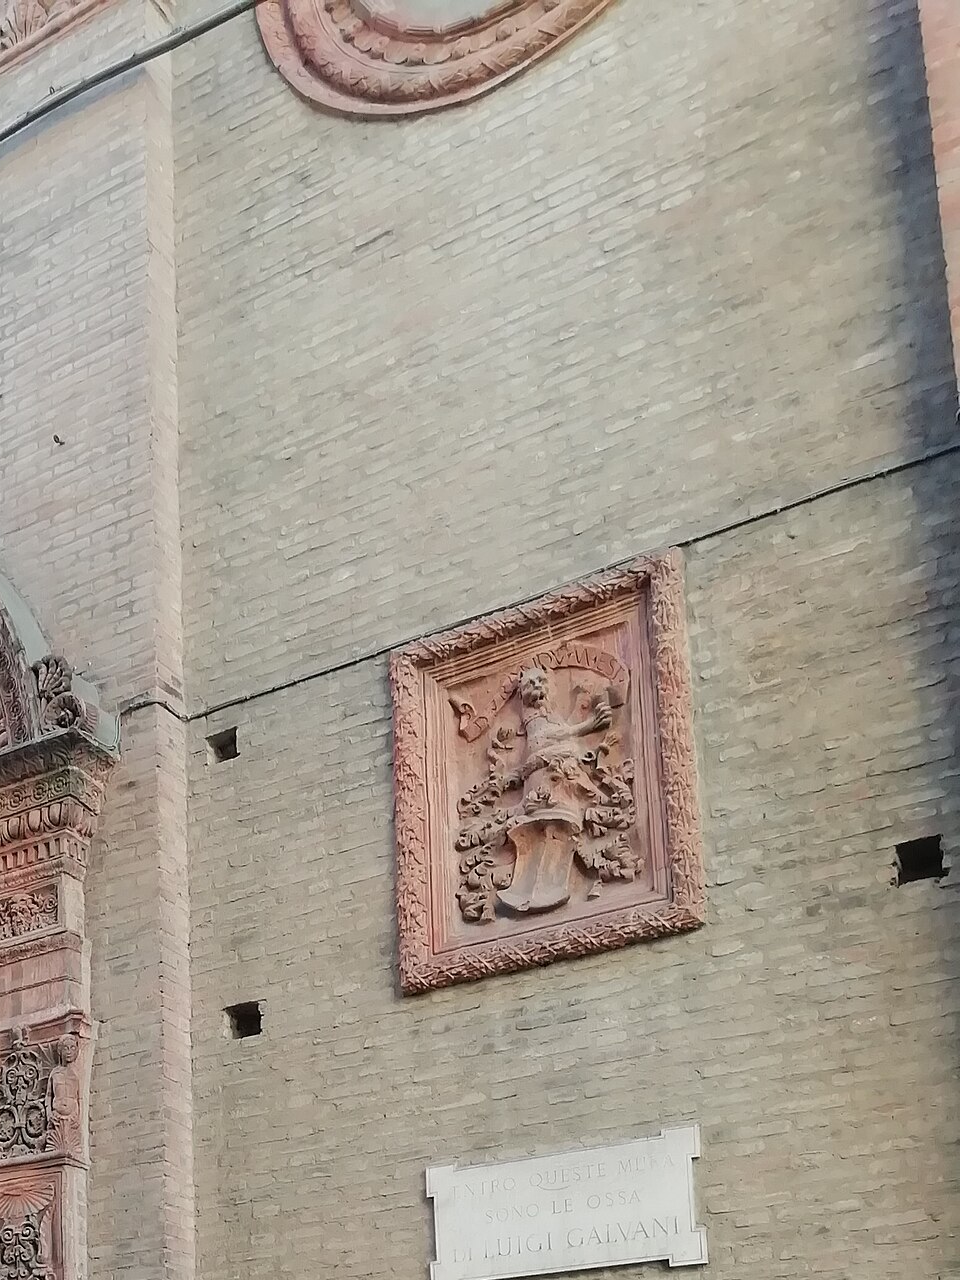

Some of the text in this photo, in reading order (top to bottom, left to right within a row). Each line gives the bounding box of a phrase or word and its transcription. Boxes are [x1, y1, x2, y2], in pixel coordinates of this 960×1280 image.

[529, 1162, 606, 1191] QUESTE
[617, 1154, 675, 1176] MURA
[485, 1190, 641, 1224] SONO LE OSSA
[453, 1216, 680, 1263] DI LUIGI GALVANI
